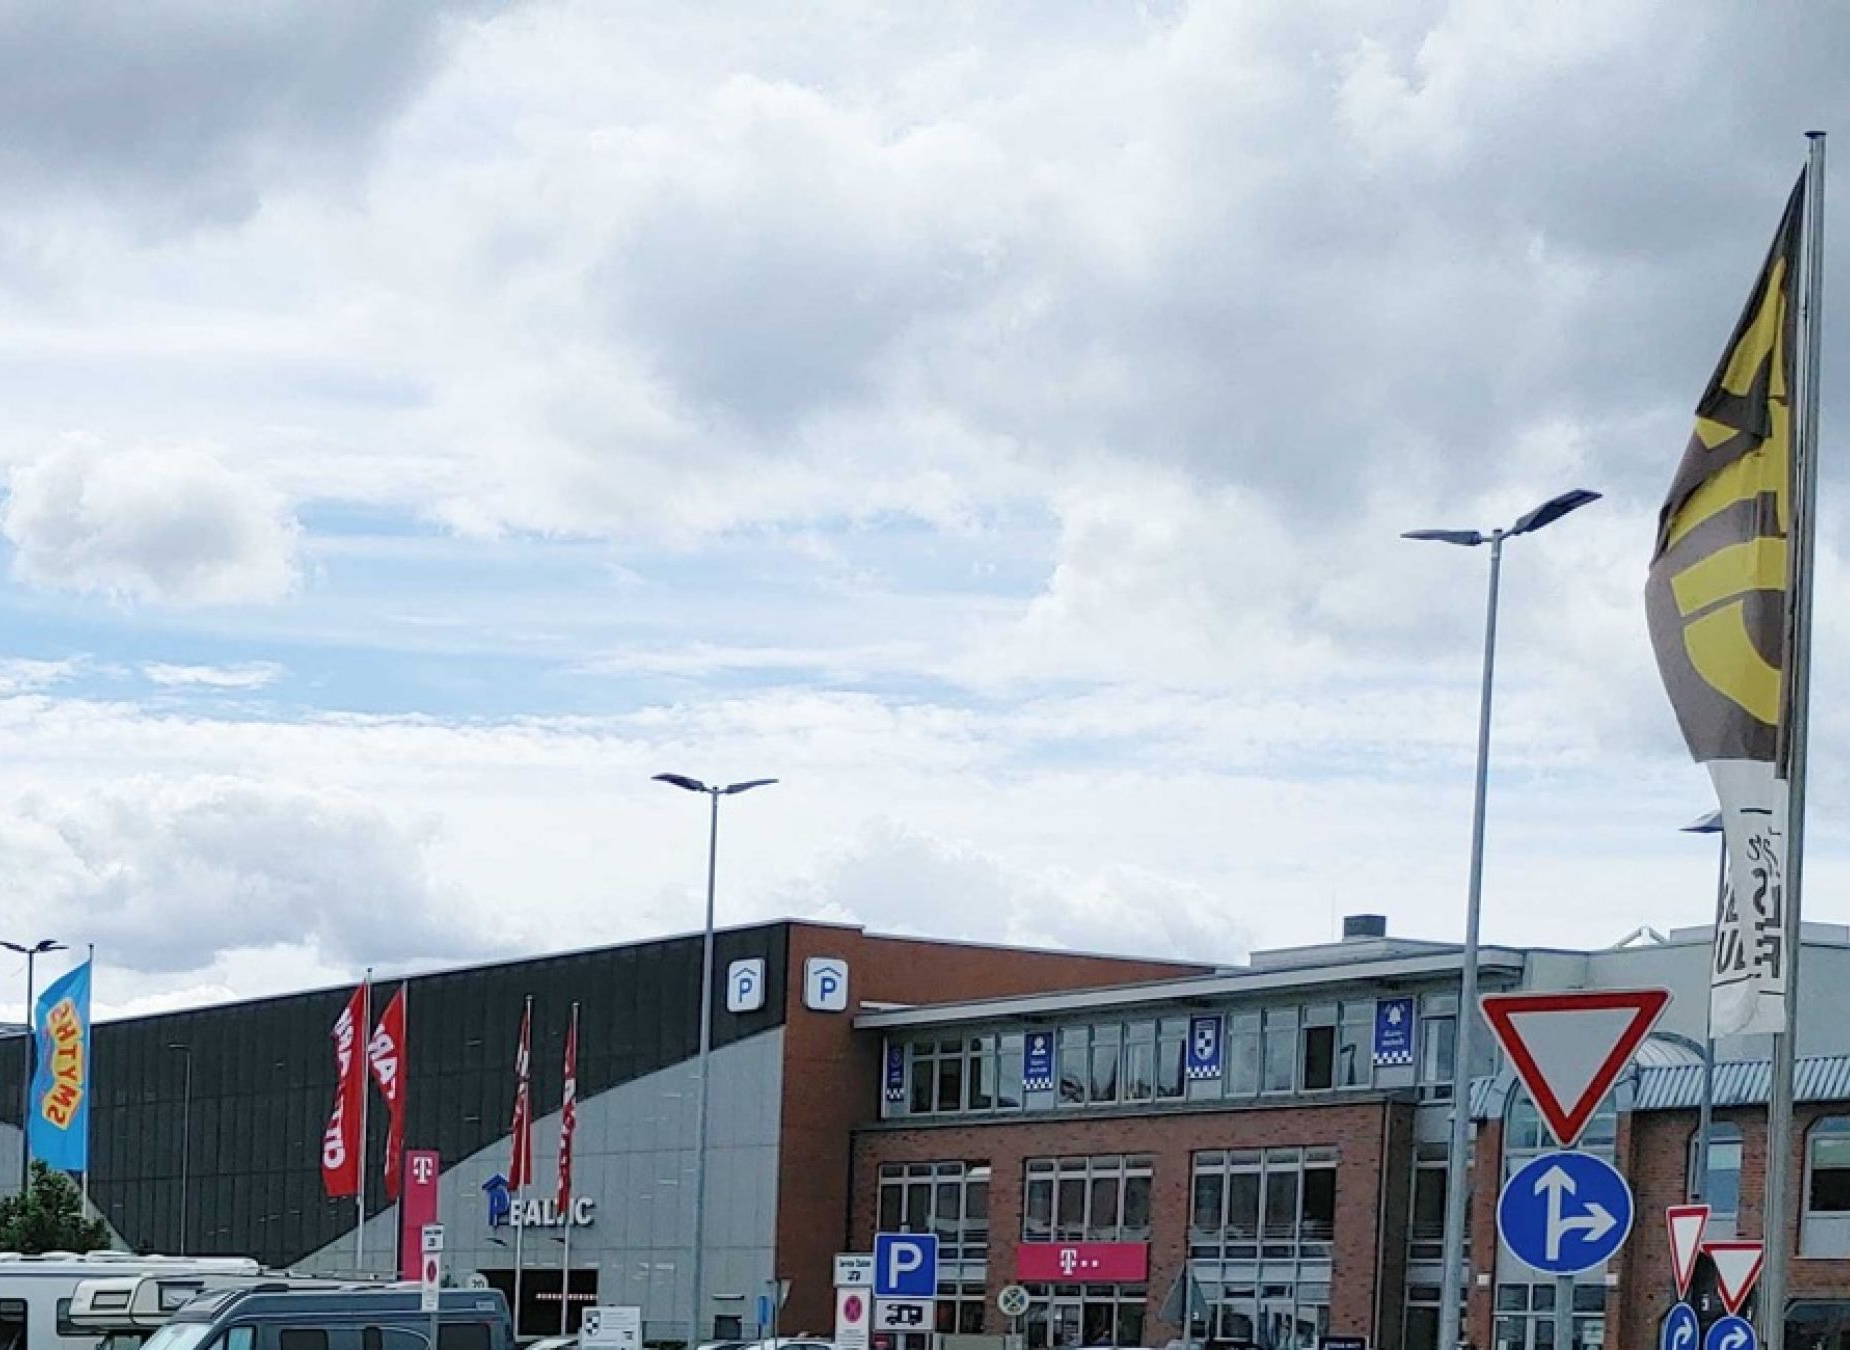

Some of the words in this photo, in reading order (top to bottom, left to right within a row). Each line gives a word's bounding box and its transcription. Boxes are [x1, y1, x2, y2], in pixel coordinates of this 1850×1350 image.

[738, 977, 753, 1004] P
[820, 977, 837, 1002] P
[413, 1156, 433, 1184] T
[510, 1197, 594, 1227] BALIC
[888, 1241, 924, 1289] P
